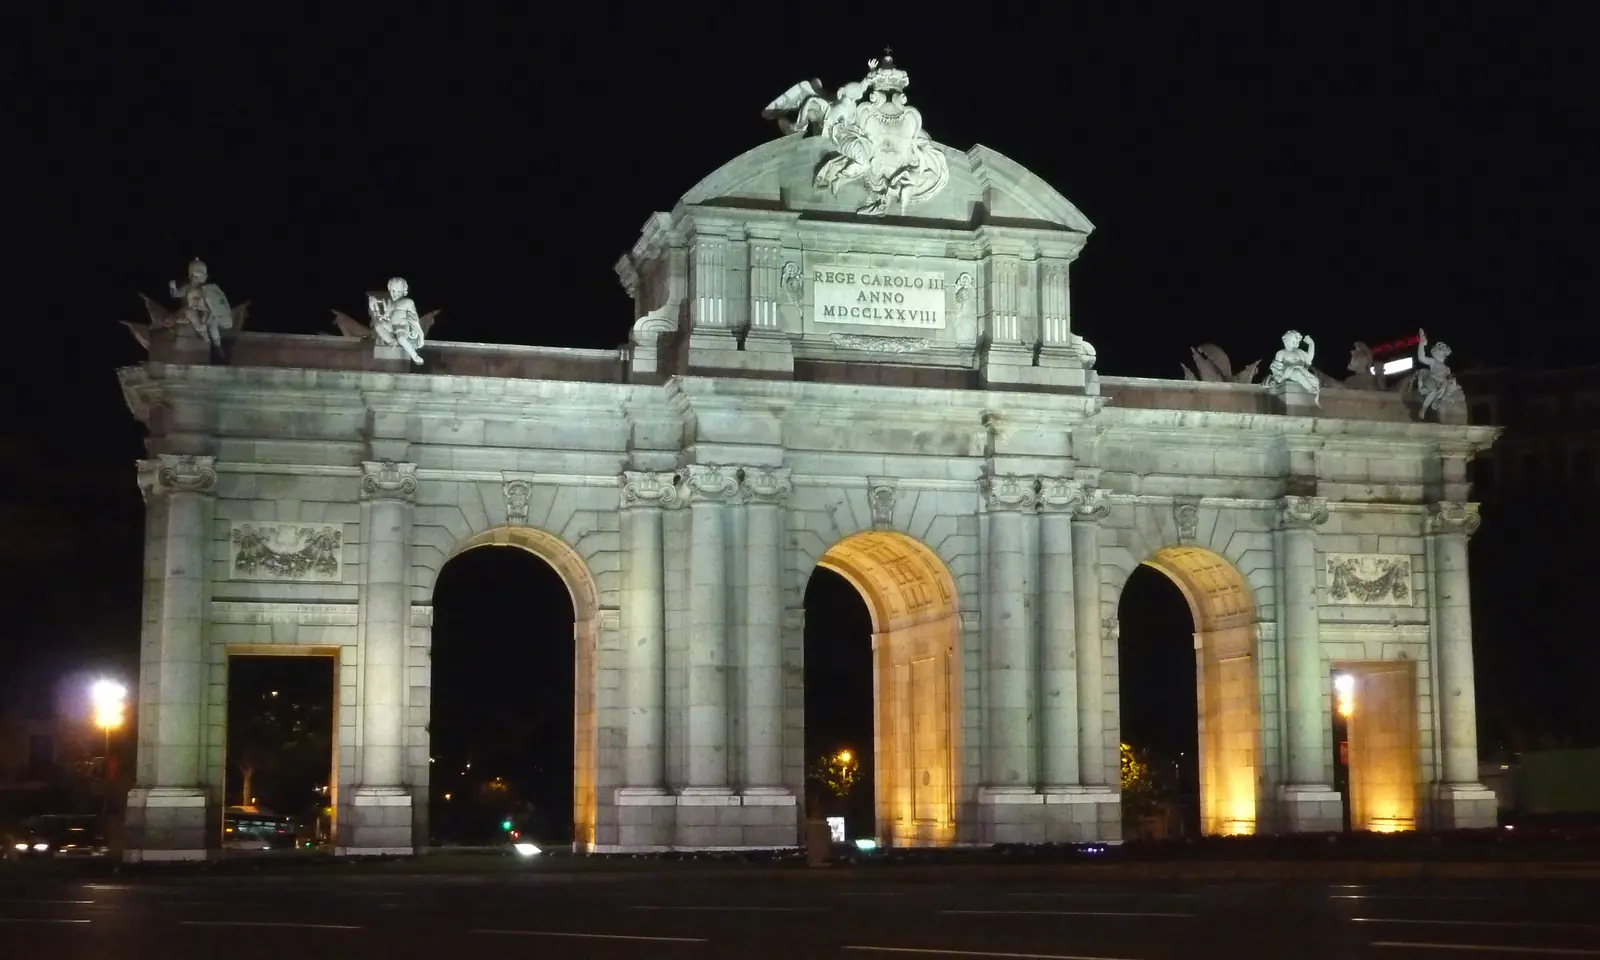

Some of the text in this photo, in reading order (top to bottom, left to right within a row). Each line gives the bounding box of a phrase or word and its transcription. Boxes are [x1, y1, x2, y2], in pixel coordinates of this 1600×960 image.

[814, 271, 945, 290] REGE CAROLO III
[857, 290, 904, 303] ANNO
[823, 305, 936, 322] MDCCLXXVIII
